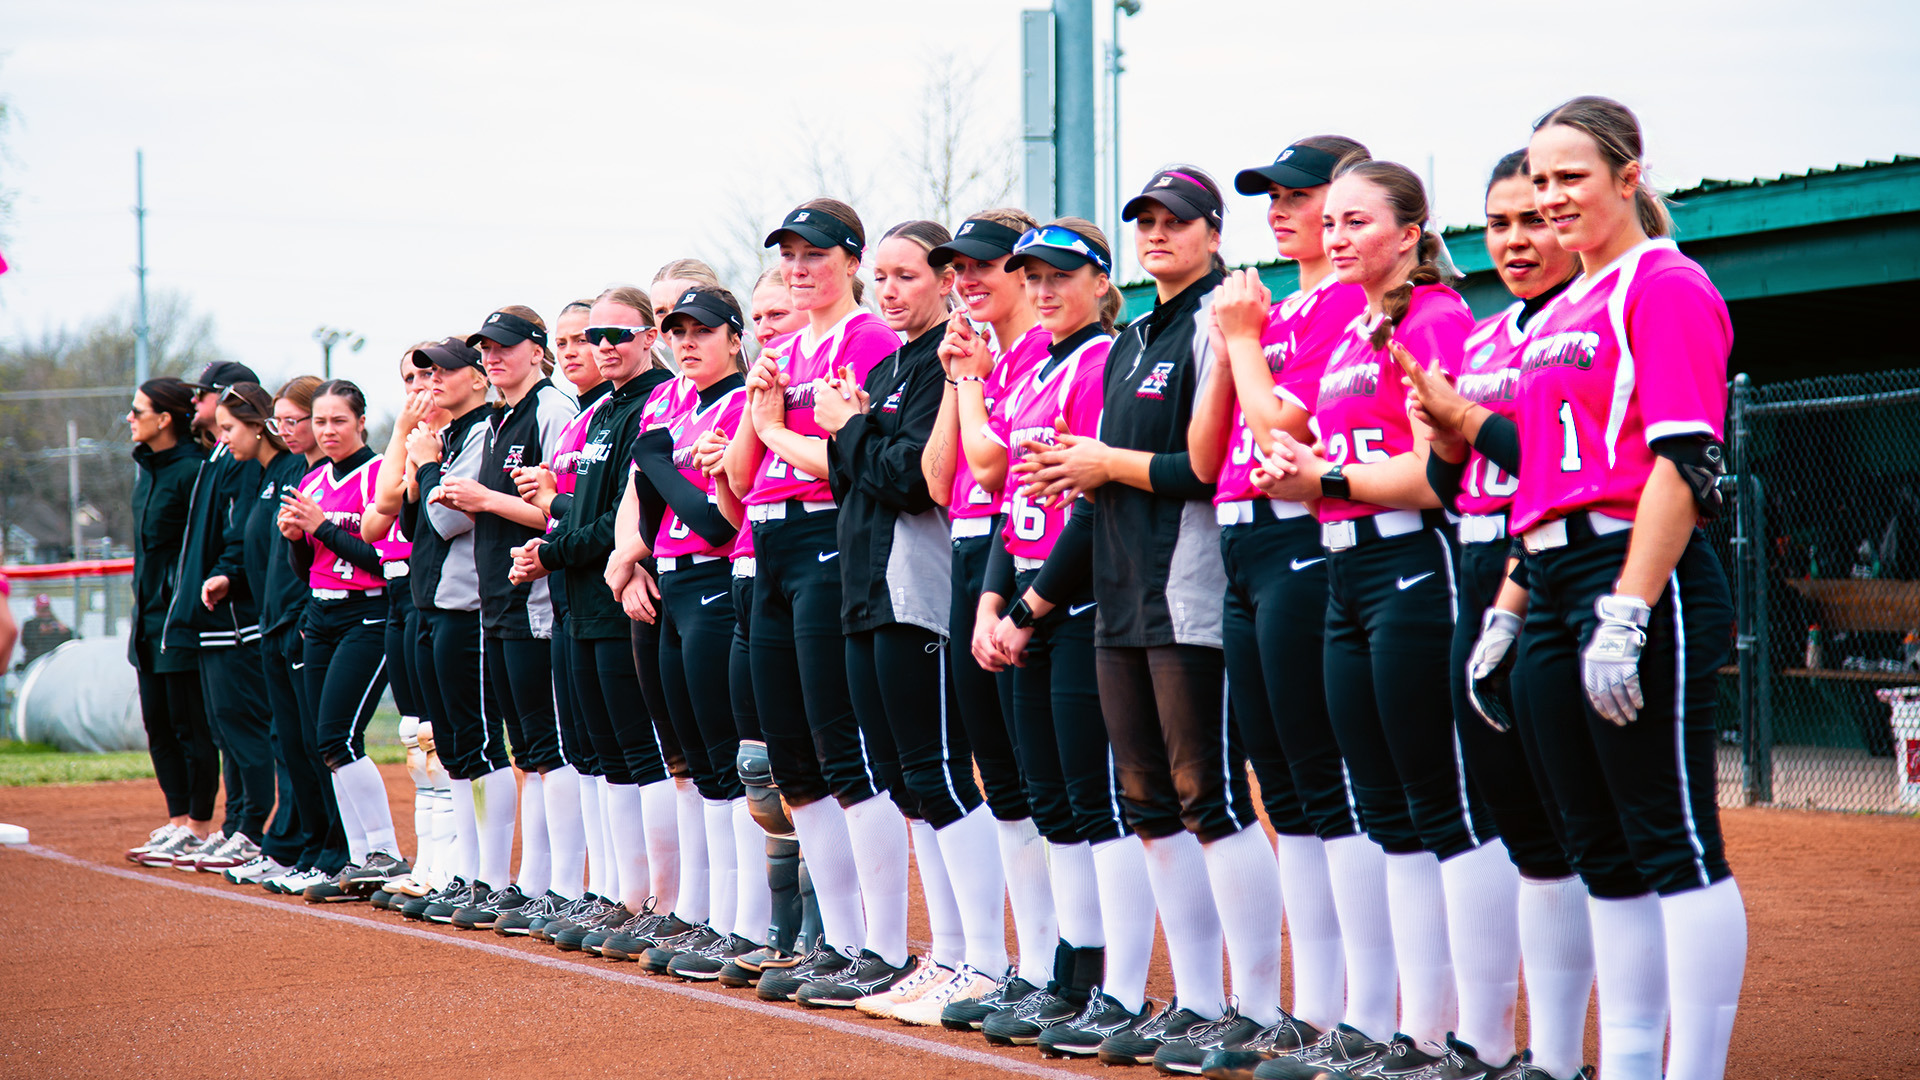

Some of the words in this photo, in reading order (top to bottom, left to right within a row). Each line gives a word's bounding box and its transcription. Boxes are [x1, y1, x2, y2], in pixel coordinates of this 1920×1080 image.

[1328, 427, 1391, 464] 25
[1558, 400, 1582, 473] 1
[1012, 484, 1047, 541] 6
[333, 557, 354, 580] 4
